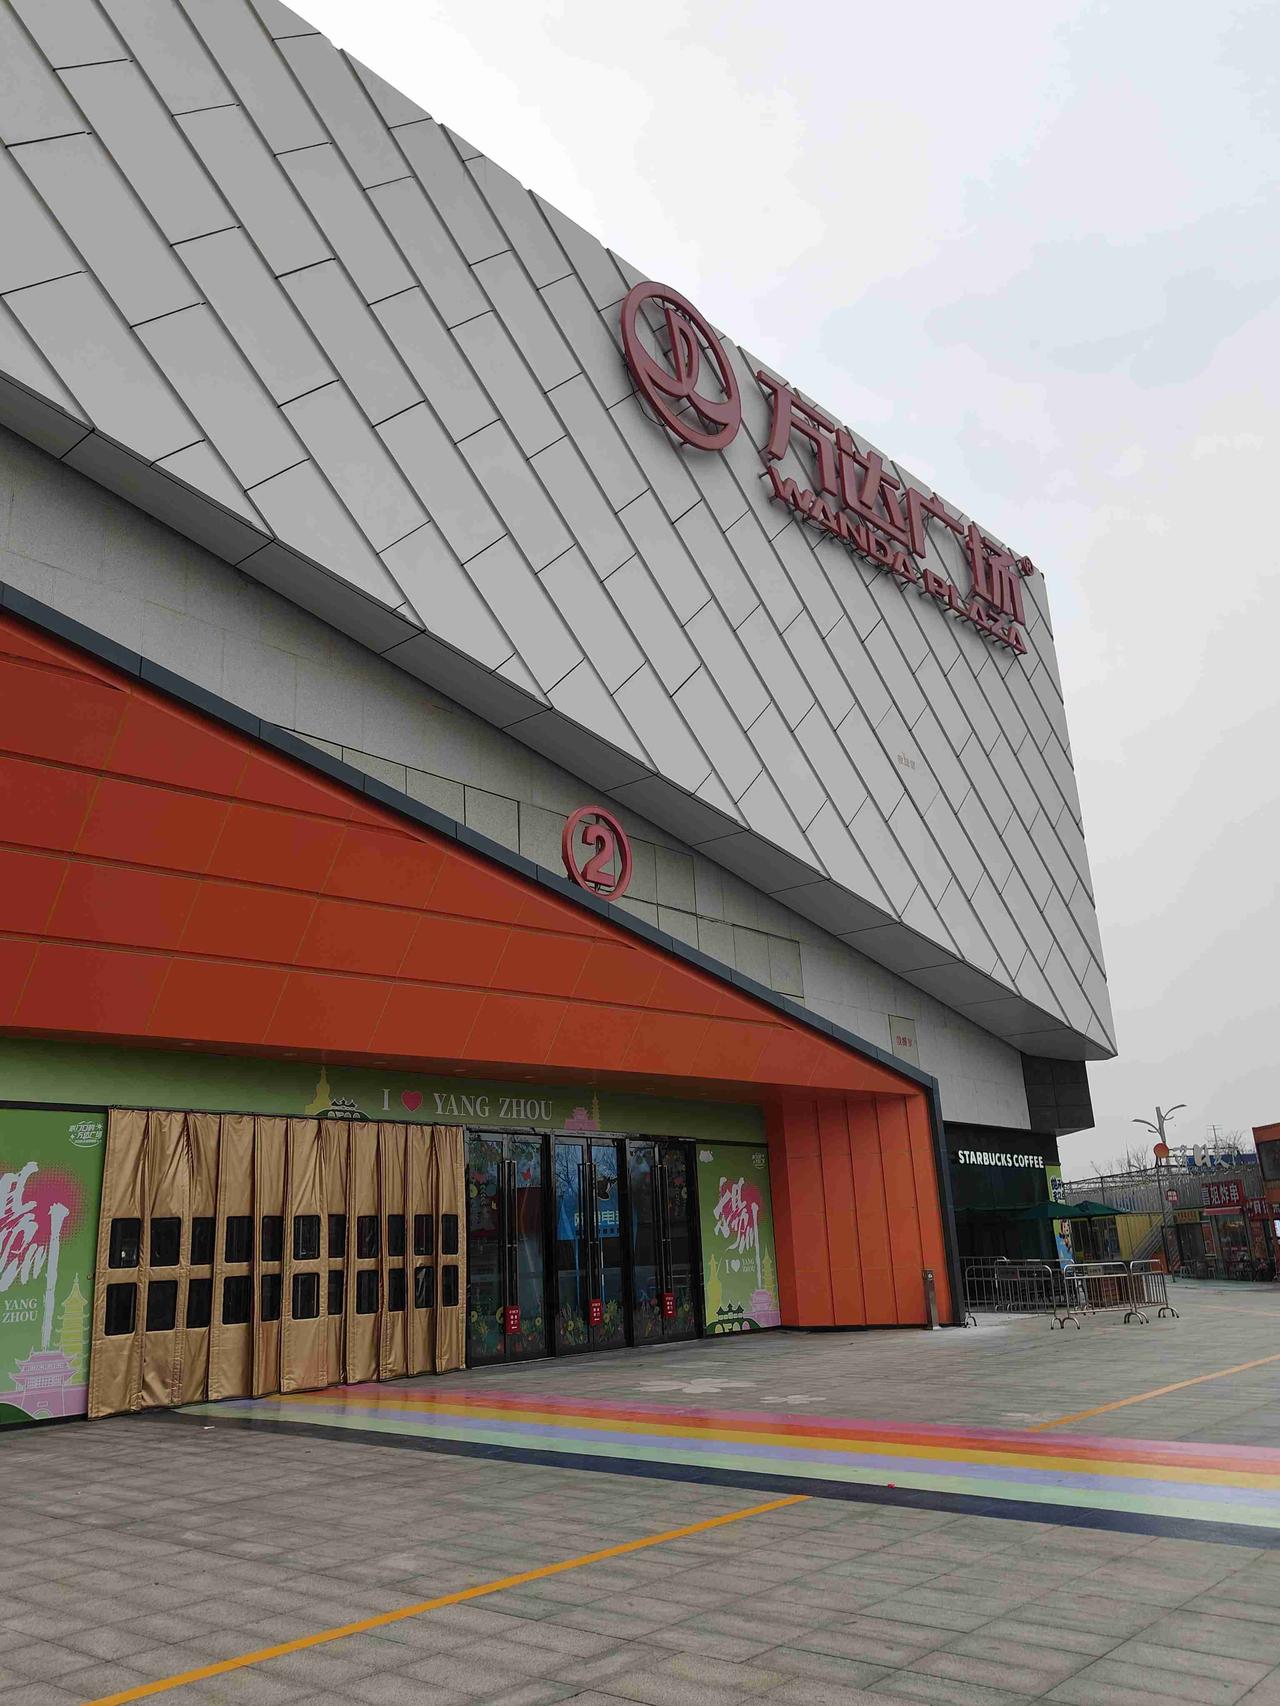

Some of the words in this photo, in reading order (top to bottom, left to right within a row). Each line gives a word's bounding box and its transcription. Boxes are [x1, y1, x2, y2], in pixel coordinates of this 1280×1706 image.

[756, 370, 1027, 626] 万达广场
[767, 465, 917, 583] WANDA
[923, 568, 1028, 655] PLAZA
[582, 824, 615, 888] 2
[381, 1088, 391, 1111] I
[433, 1092, 489, 1116] YANG
[499, 1098, 553, 1121] ZHOU
[958, 1149, 1012, 1167] STARBUCKS
[1013, 1154, 1044, 1169] COFFEE
[2, 1310, 38, 1323] ZHOU
[4, 1299, 38, 1310] YANG
